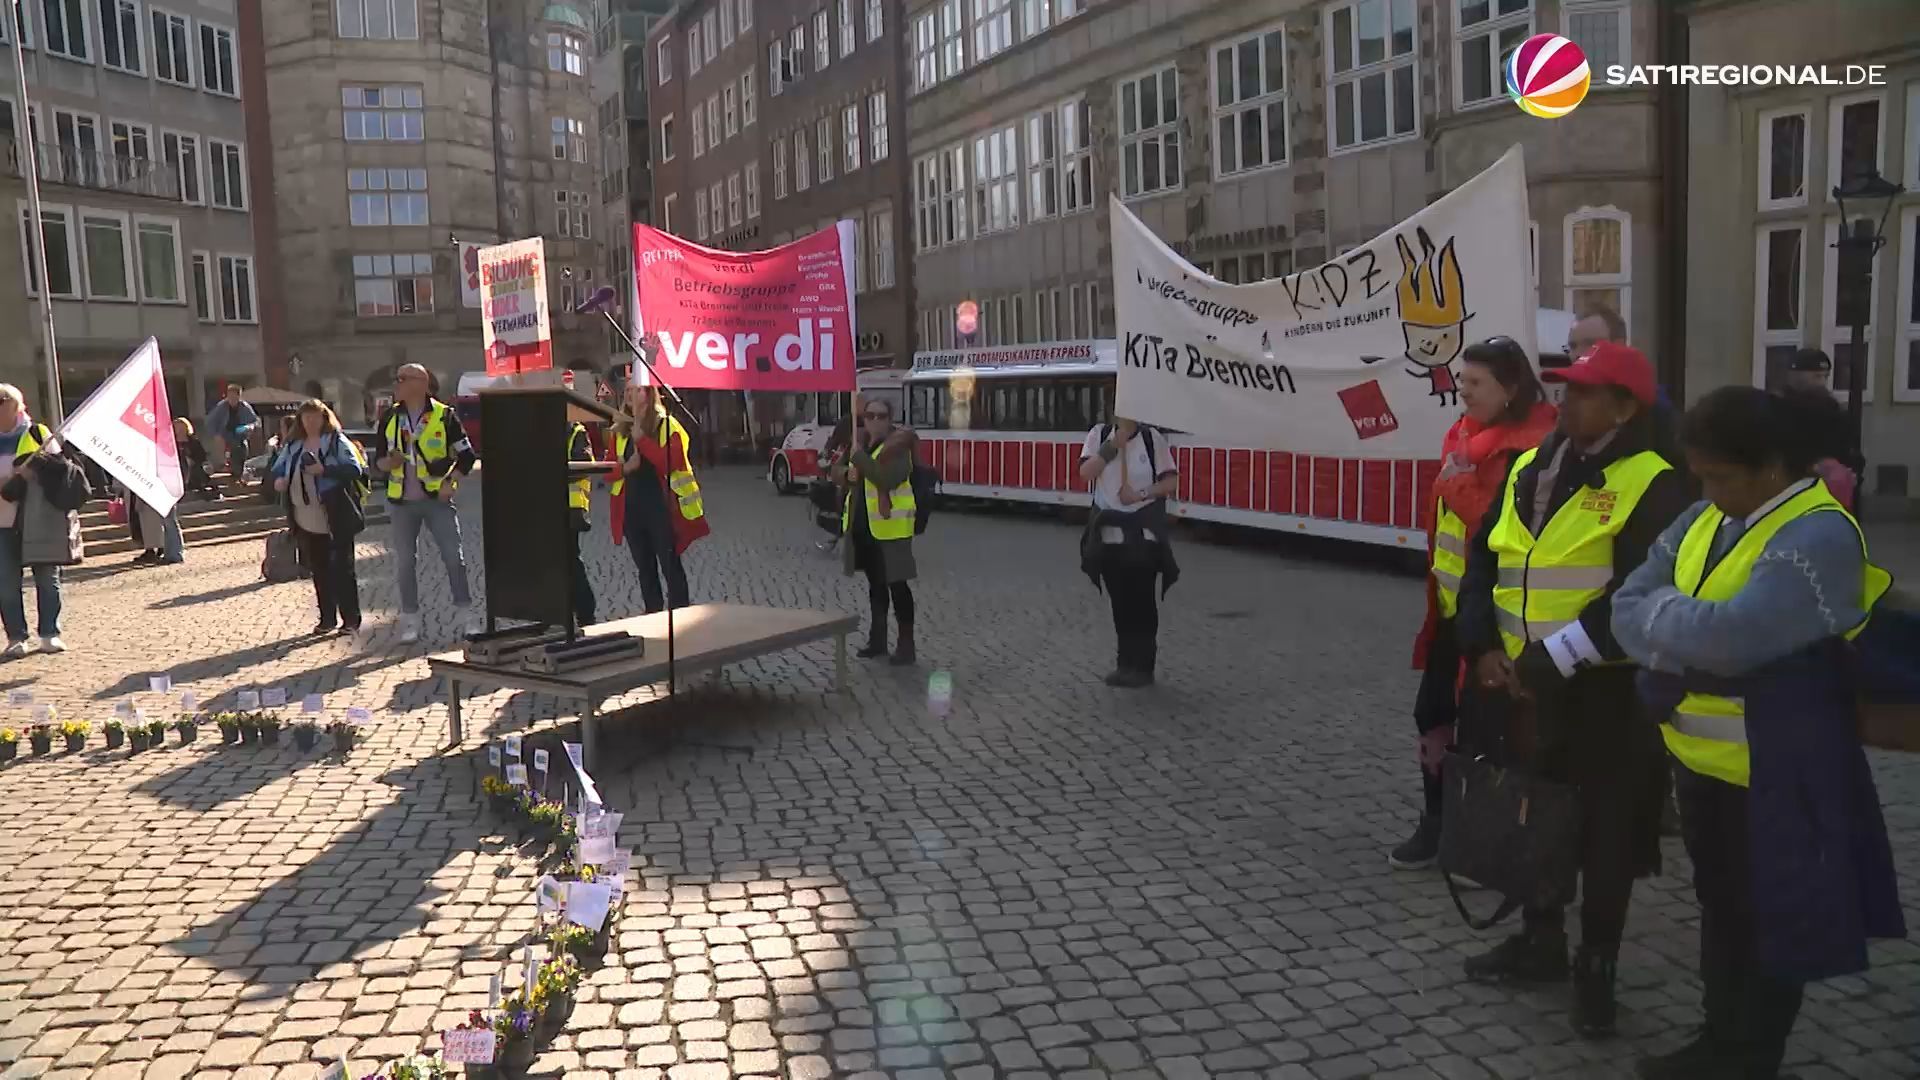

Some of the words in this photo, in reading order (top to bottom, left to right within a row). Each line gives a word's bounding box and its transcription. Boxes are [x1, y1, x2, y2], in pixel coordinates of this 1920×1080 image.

[1325, 319, 1342, 331] DIE
[1343, 307, 1391, 327] ZUKUNFT
[656, 317, 835, 373] ver.di
[966, 345, 1092, 364] STADTMUSIKANTEN-EXPRESS
[1124, 331, 1178, 374] KiTa
[1185, 343, 1297, 394] Bremen
[113, 454, 154, 490] Bremen
